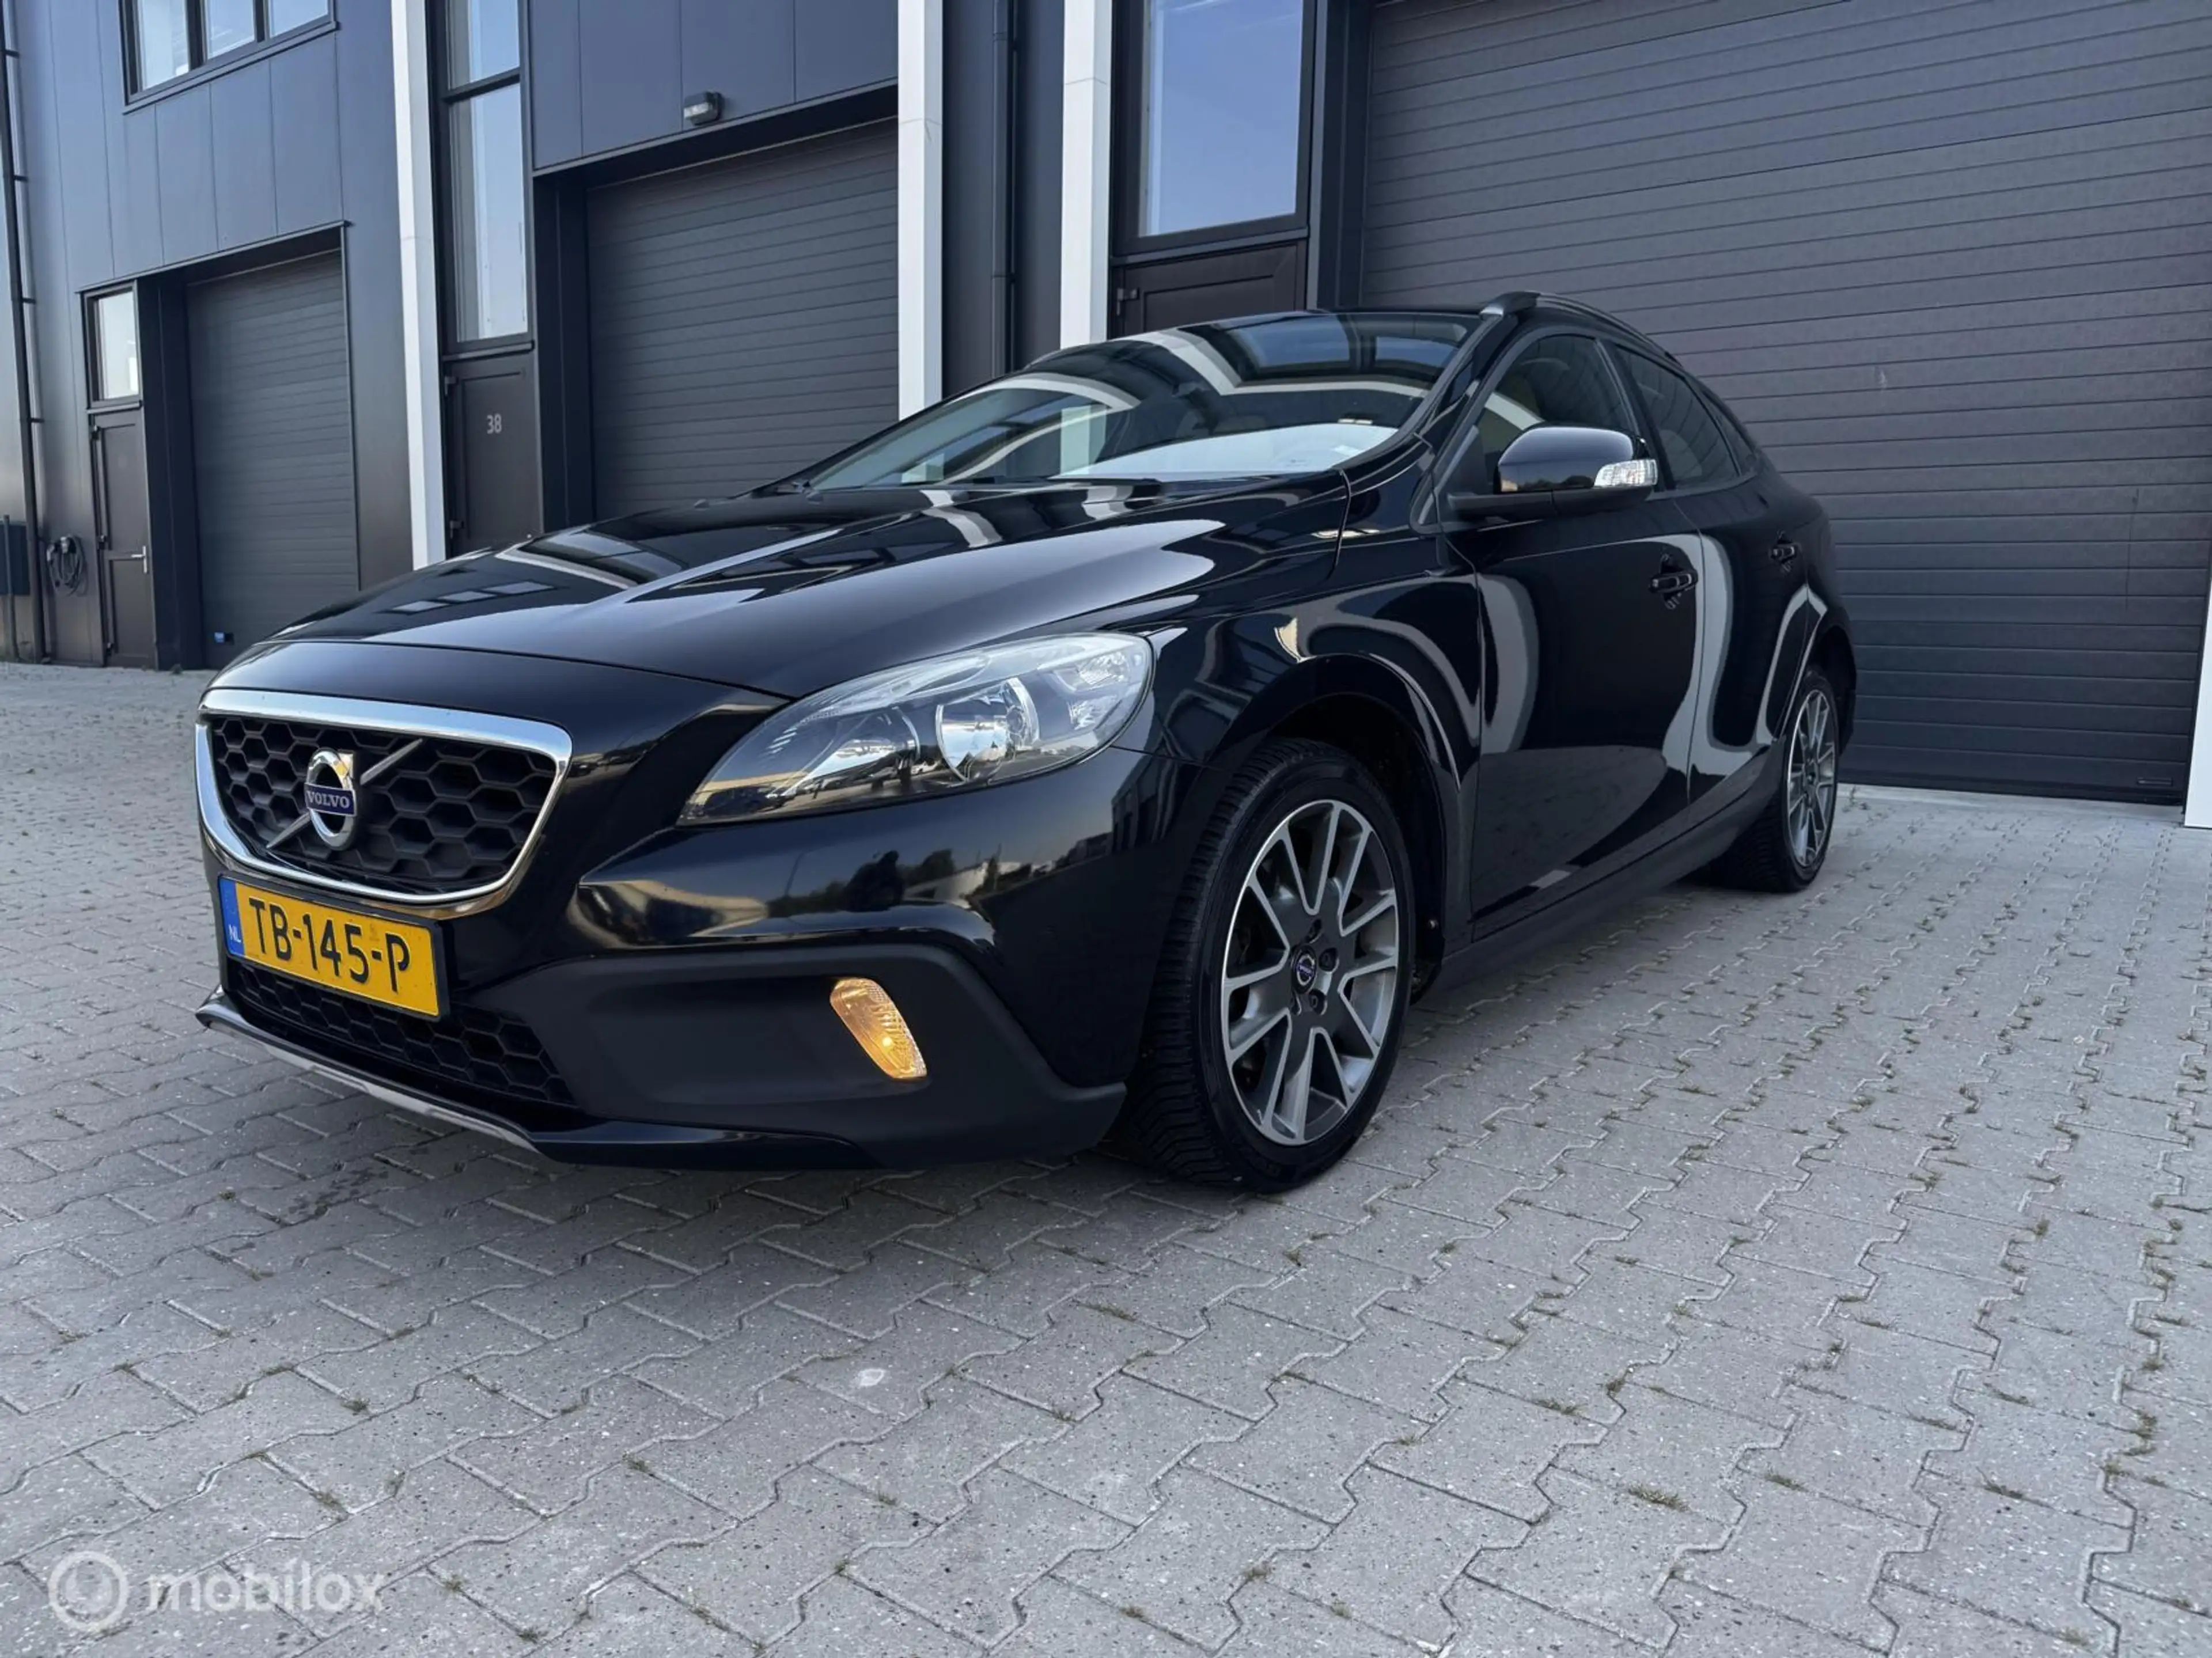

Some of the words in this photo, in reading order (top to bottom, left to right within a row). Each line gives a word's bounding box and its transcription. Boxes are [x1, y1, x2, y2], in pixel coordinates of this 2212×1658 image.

[487, 413, 502, 434] 38
[306, 790, 350, 809] VOLVO
[229, 924, 242, 943] NL
[249, 897, 411, 993] TB-145-P
